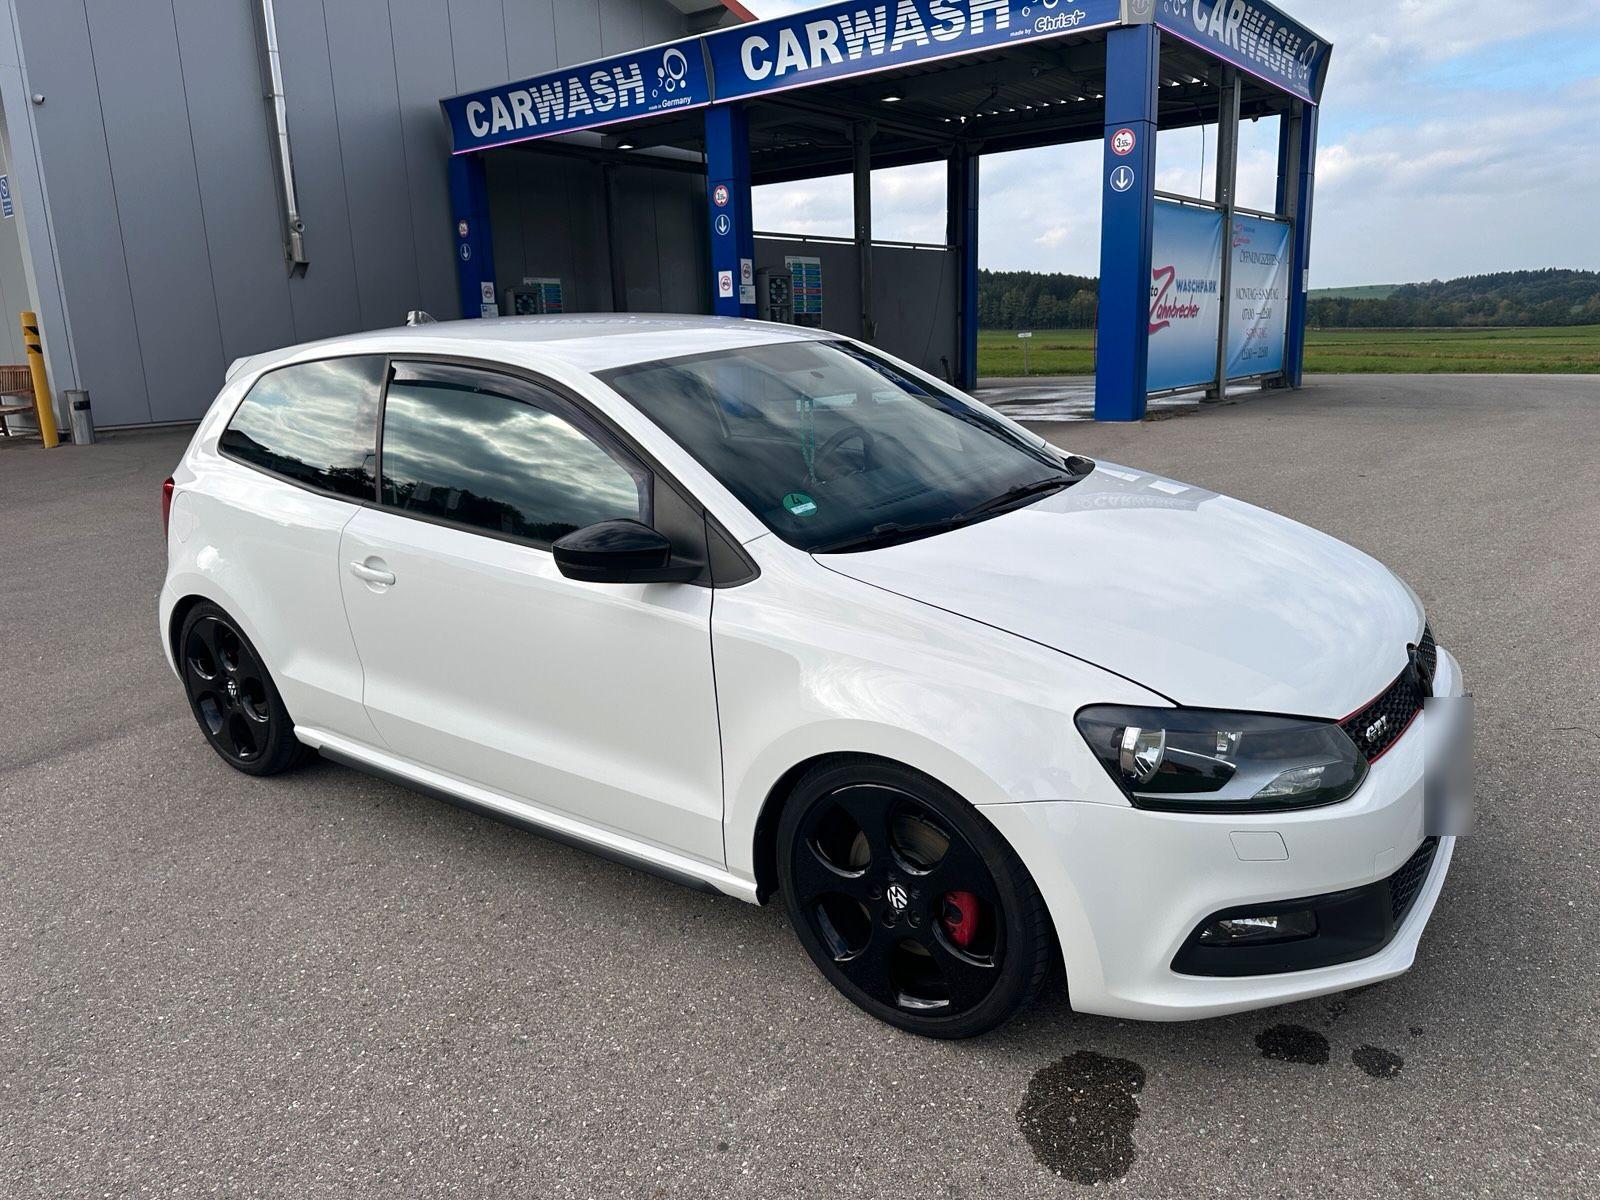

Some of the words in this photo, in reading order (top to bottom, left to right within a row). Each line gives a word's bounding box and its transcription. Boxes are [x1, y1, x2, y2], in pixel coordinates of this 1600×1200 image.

[1034, 9, 1085, 33] Christ
[739, 0, 1010, 81] CARWASH
[1192, 0, 1302, 80] CARWASH
[465, 62, 645, 138] CARWASH
[662, 96, 692, 108] Germany
[1176, 279, 1217, 294] WASCHPARK
[790, 494, 803, 505] 4
[1365, 715, 1387, 743] GTI
